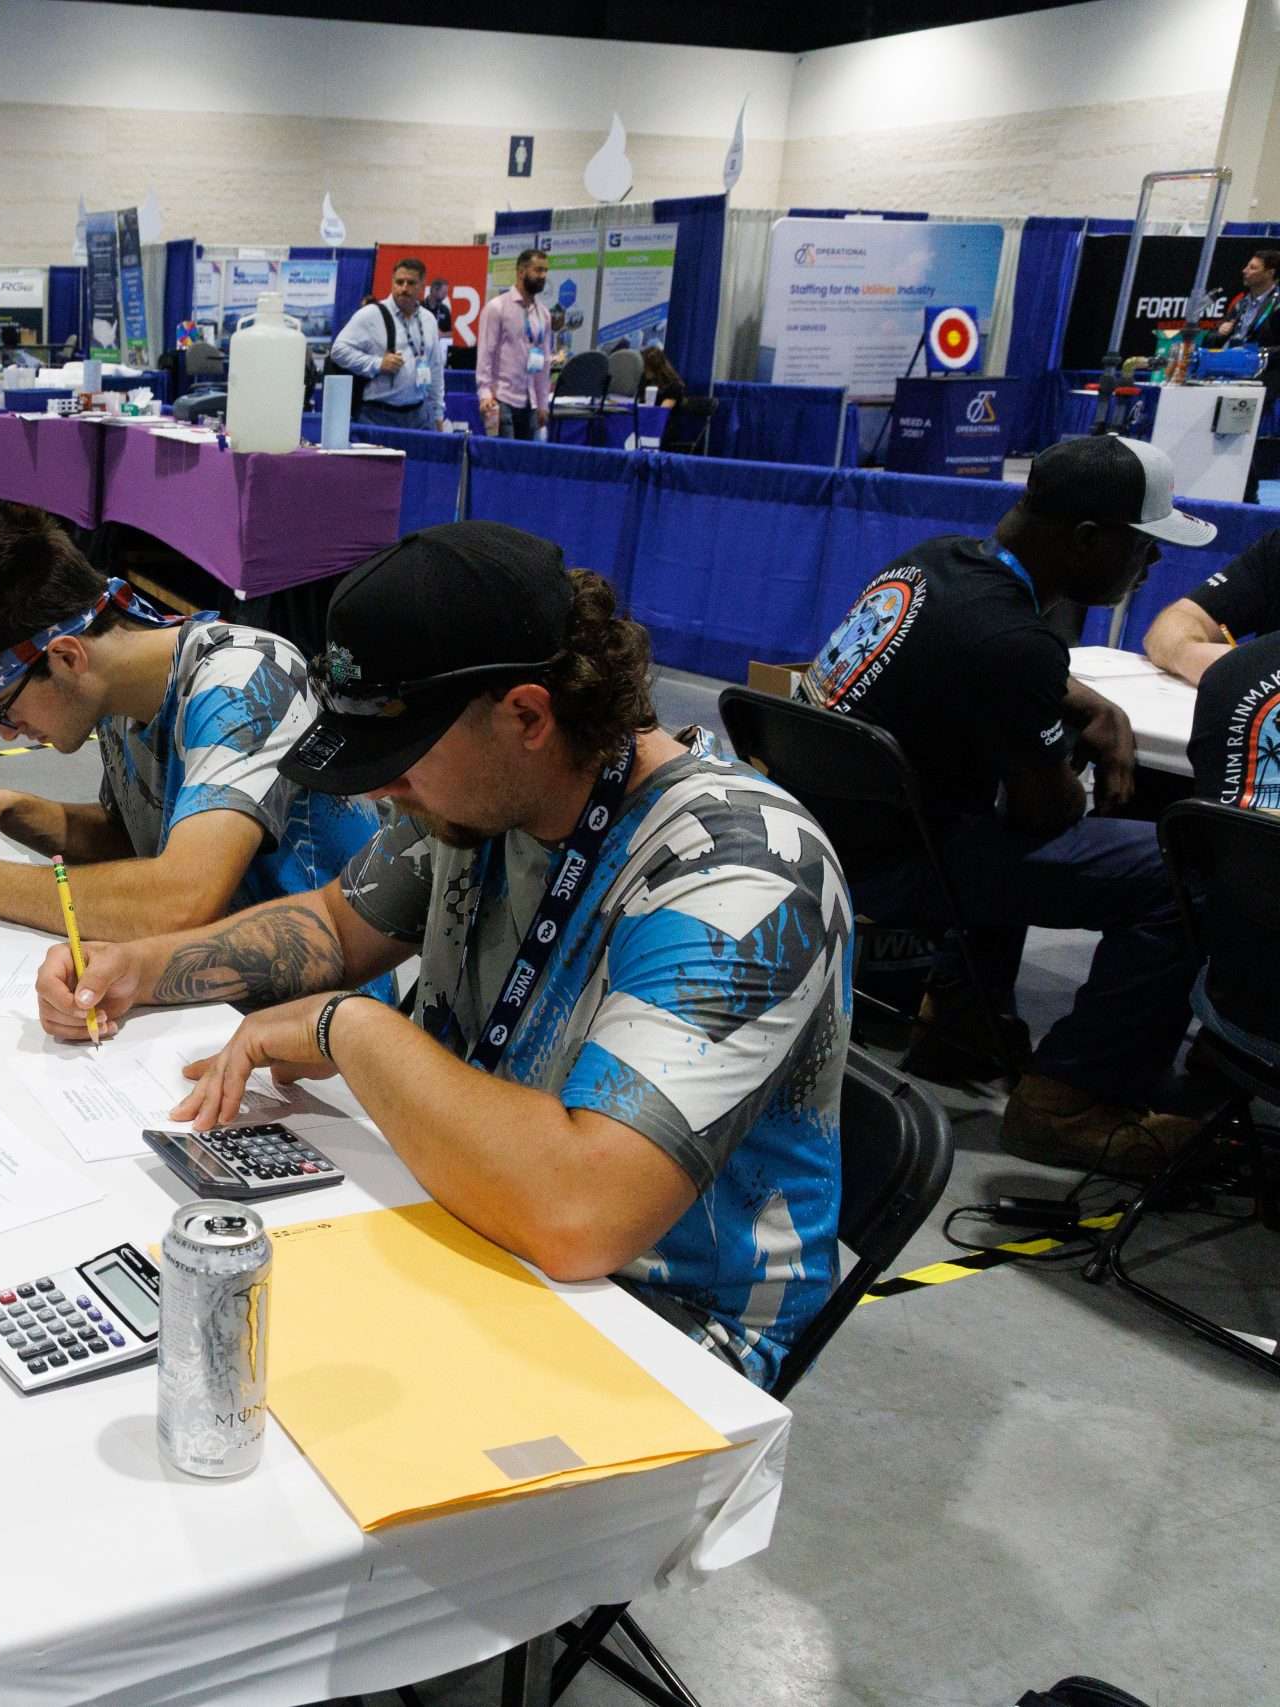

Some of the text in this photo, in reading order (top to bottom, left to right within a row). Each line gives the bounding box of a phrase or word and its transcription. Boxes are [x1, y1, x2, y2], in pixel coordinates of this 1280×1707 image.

[790, 284, 827, 298] Staffing
[829, 284, 842, 295] for
[844, 284, 860, 295] the
[898, 285, 936, 298] Industry
[1135, 297, 1228, 319] FORTINE
[1220, 753, 1243, 805] CLAIM
[557, 857, 586, 900] FWRC
[508, 966, 536, 1007] FWRC
[230, 1240, 258, 1257] ZERO
[166, 1254, 197, 1276] ONSTER
